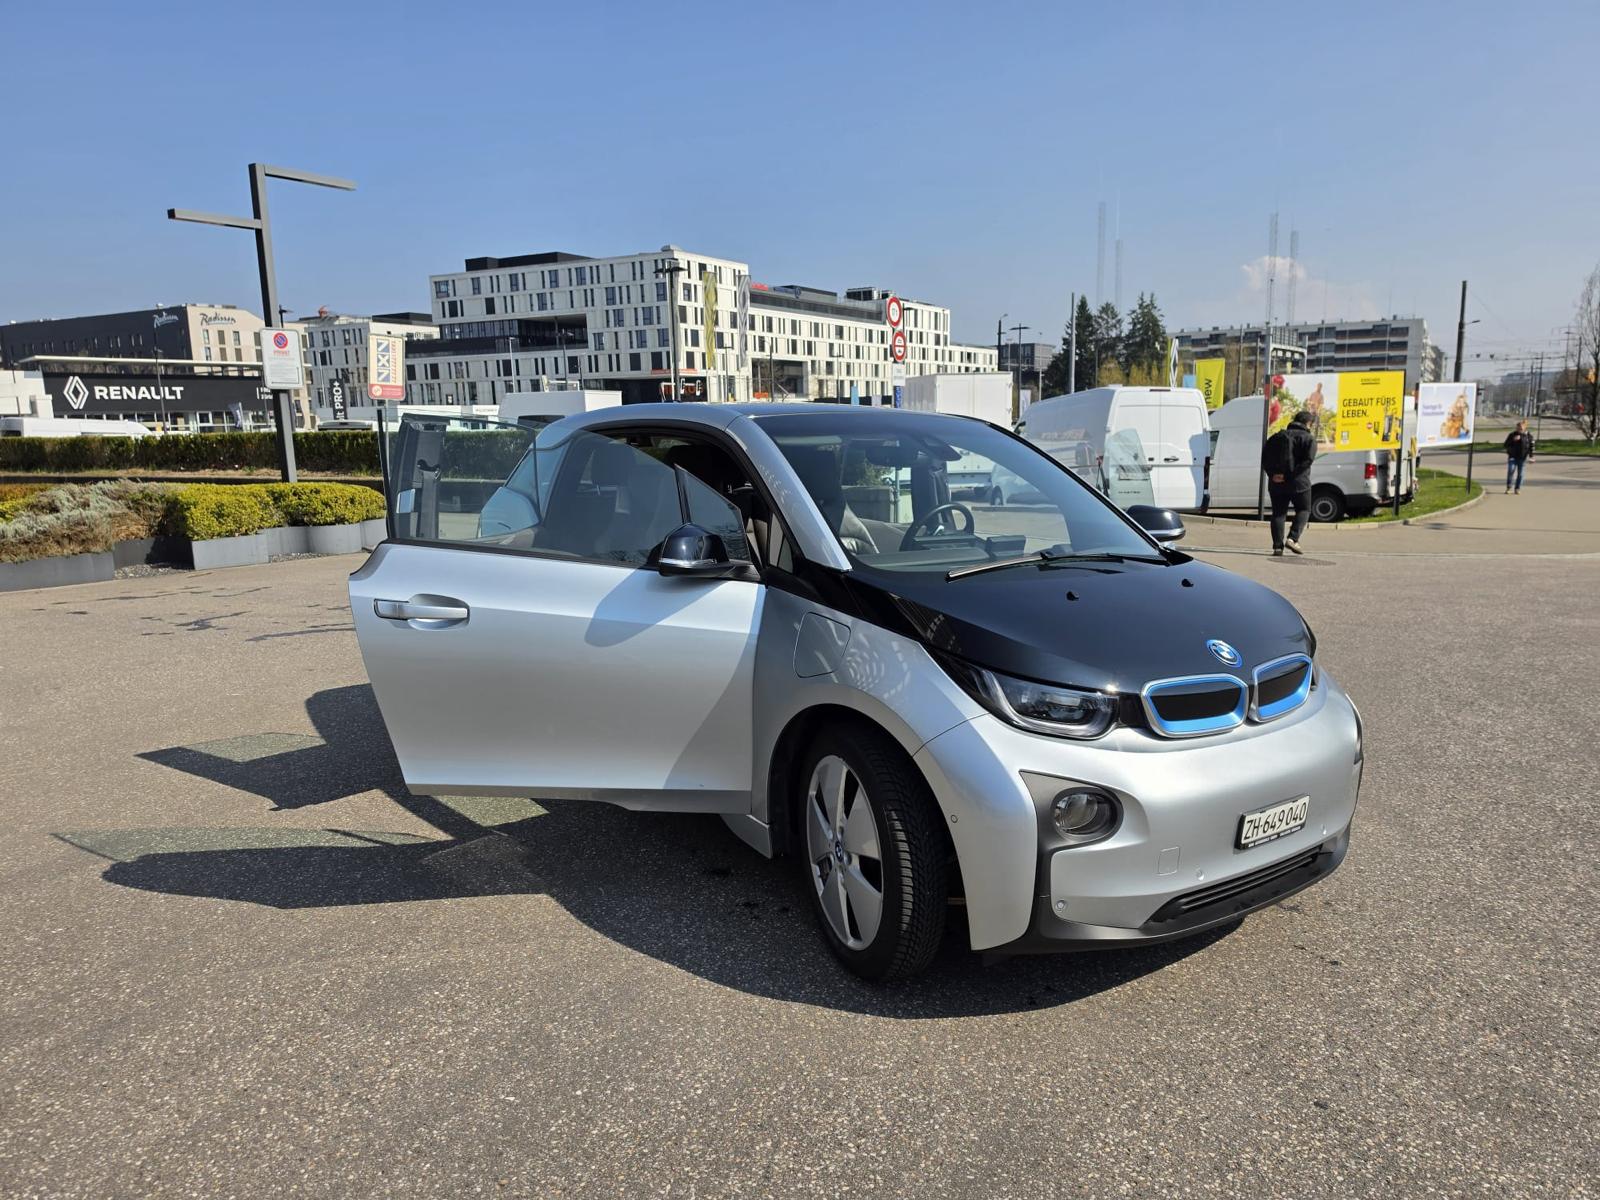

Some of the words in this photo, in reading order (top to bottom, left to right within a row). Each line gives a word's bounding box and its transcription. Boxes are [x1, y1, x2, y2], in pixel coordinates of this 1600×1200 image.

[200, 312, 236, 326] Radisson
[93, 386, 184, 400] RENAULT
[333, 381, 344, 410] PRO+
[1342, 398, 1373, 407] GEBAUT
[1376, 396, 1396, 406] FÜRS
